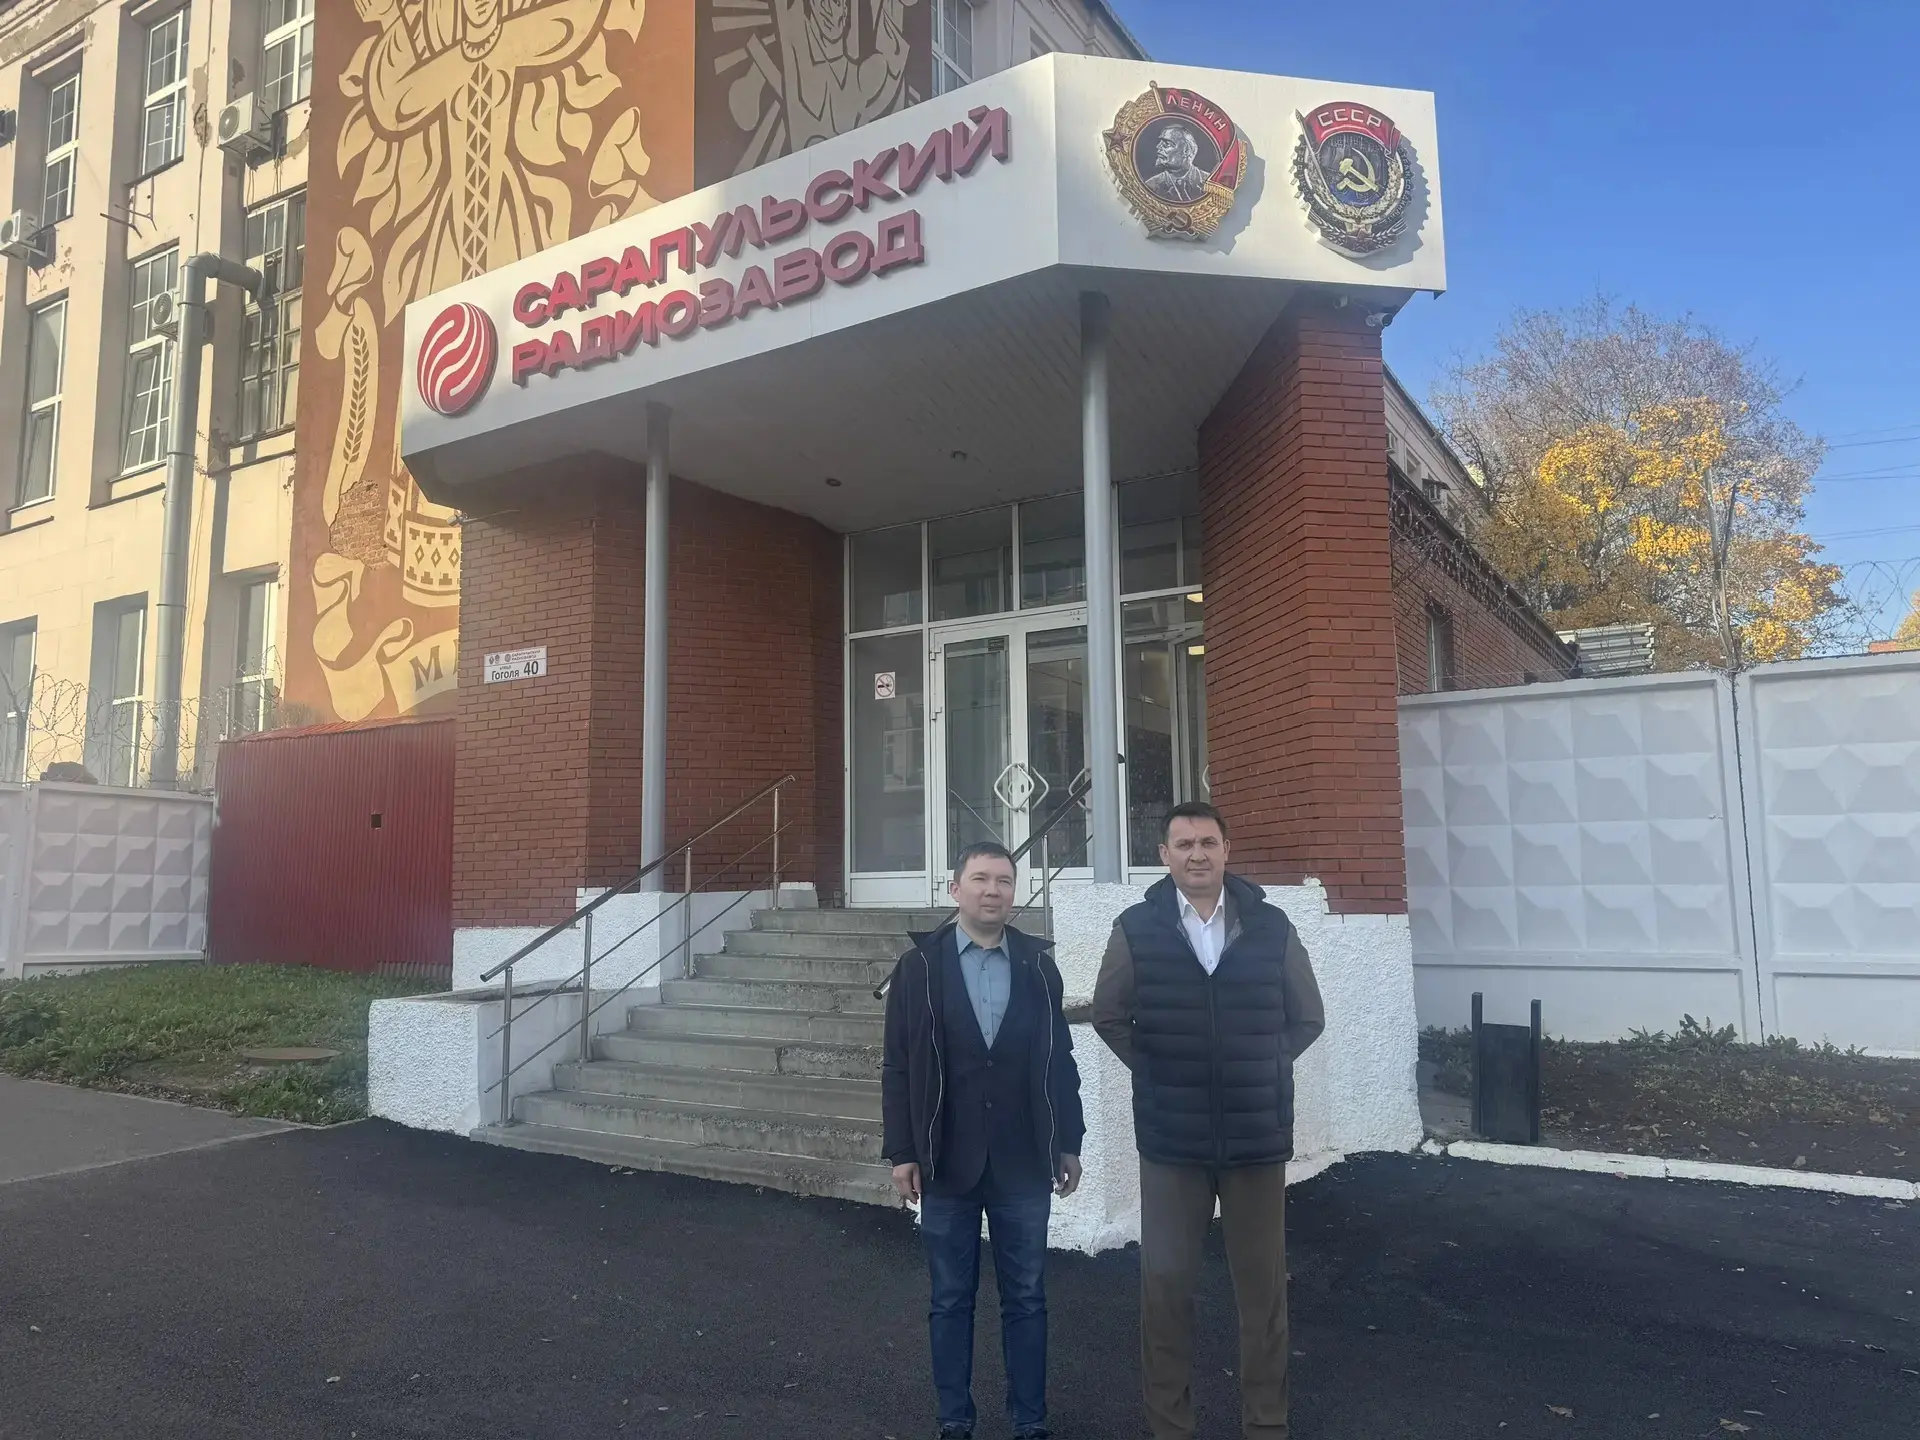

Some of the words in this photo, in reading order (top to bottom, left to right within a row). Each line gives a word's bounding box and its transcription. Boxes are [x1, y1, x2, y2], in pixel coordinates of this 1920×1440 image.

[1167, 94, 1227, 132] ЛЕНИН
[1317, 108, 1382, 128] СССР
[513, 105, 1009, 329] САРАПУЛЬСКИЙ
[512, 209, 925, 387] РАДИОЗАВОД
[491, 670, 520, 681] Гоголя
[523, 660, 539, 676] 40
